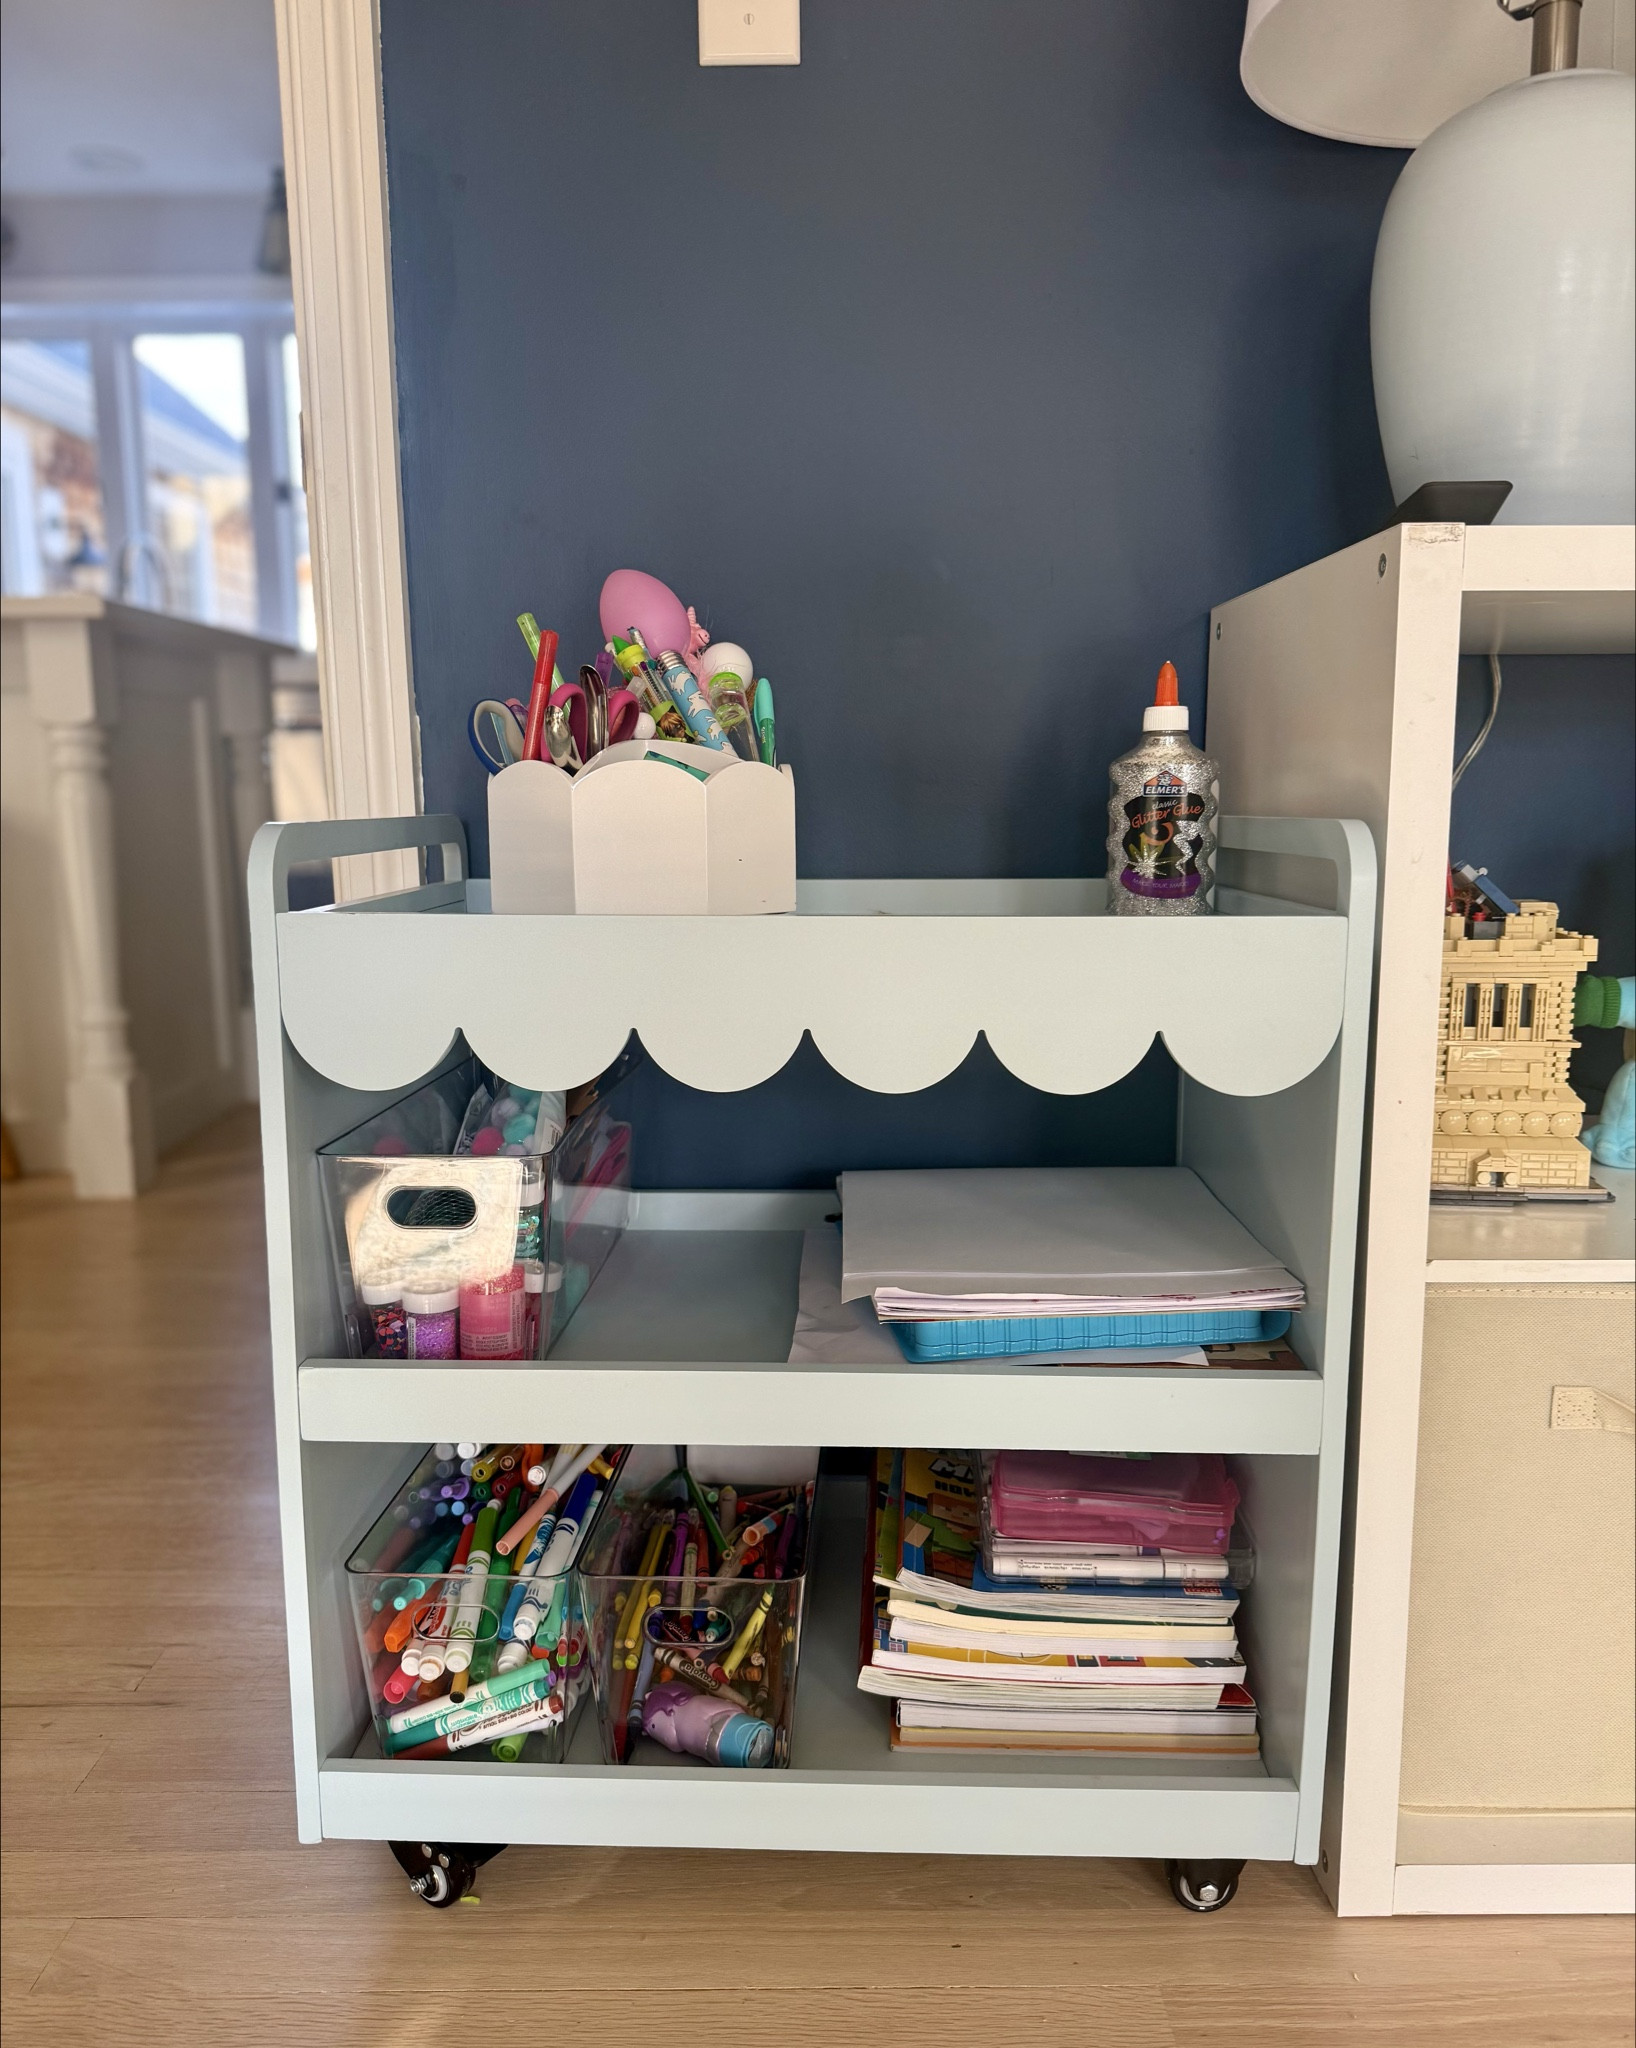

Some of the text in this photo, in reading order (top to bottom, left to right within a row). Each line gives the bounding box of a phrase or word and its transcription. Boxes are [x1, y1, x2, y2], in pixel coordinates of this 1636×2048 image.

[1145, 786, 1186, 794] ELMER'S
[1152, 799, 1179, 810] classic
[1131, 802, 1204, 829] Glitter Glue
[684, 1663, 719, 1689] Crayola
